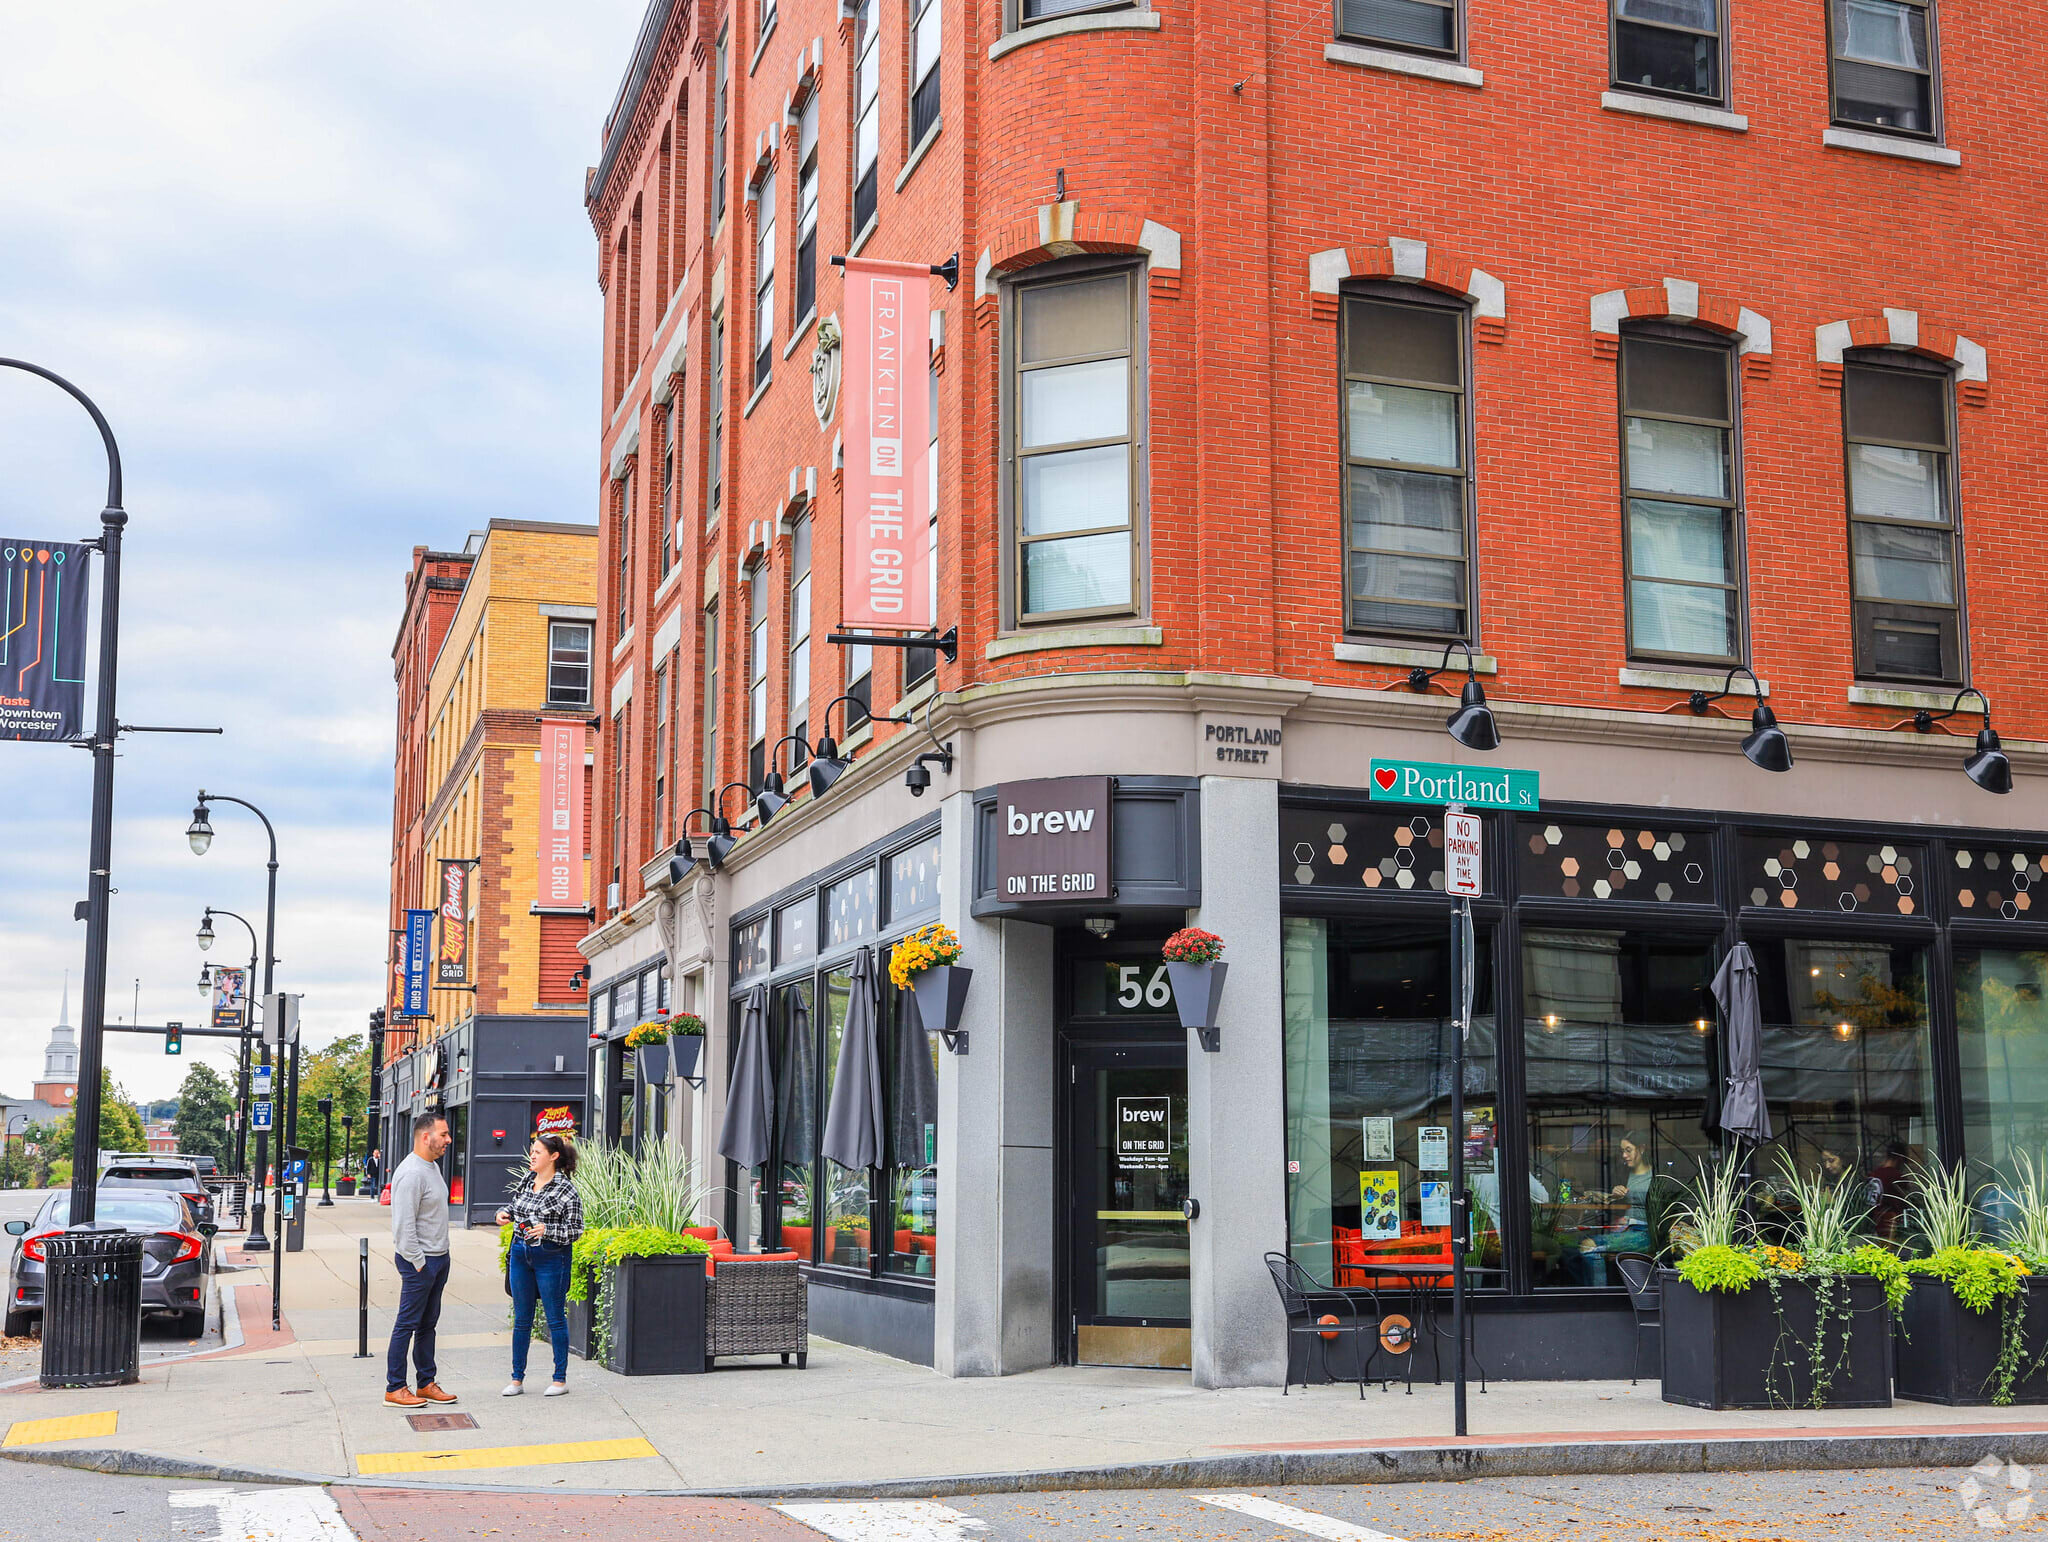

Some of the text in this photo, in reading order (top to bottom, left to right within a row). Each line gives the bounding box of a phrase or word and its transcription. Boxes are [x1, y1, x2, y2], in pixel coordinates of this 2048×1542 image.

[870, 291, 903, 614] FRANKLIN ON THE GRID
[0, 695, 30, 706] Taste
[0, 707, 61, 719] Downtown
[0, 718, 57, 730] Worcester
[1205, 724, 1281, 746] PORTLAND
[1216, 747, 1269, 763] STREET
[1402, 767, 1532, 805] Portland St
[551, 734, 569, 899] FRANKLIN ON THE GRID
[1007, 805, 1095, 835] brew
[1456, 821, 1470, 837] NO
[1449, 838, 1479, 856] PARKING
[1456, 856, 1470, 866] ANY
[1456, 867, 1471, 879] TIME
[442, 863, 465, 920] Bombs
[1007, 873, 1095, 894] ON THE GRID
[411, 974, 422, 989] THE
[1118, 966, 1171, 1009] 56
[410, 991, 422, 1009] GRID
[1122, 1107, 1164, 1122] brew
[537, 1117, 574, 1131] Bombs
[1122, 1141, 1164, 1150] ON THE GRID
